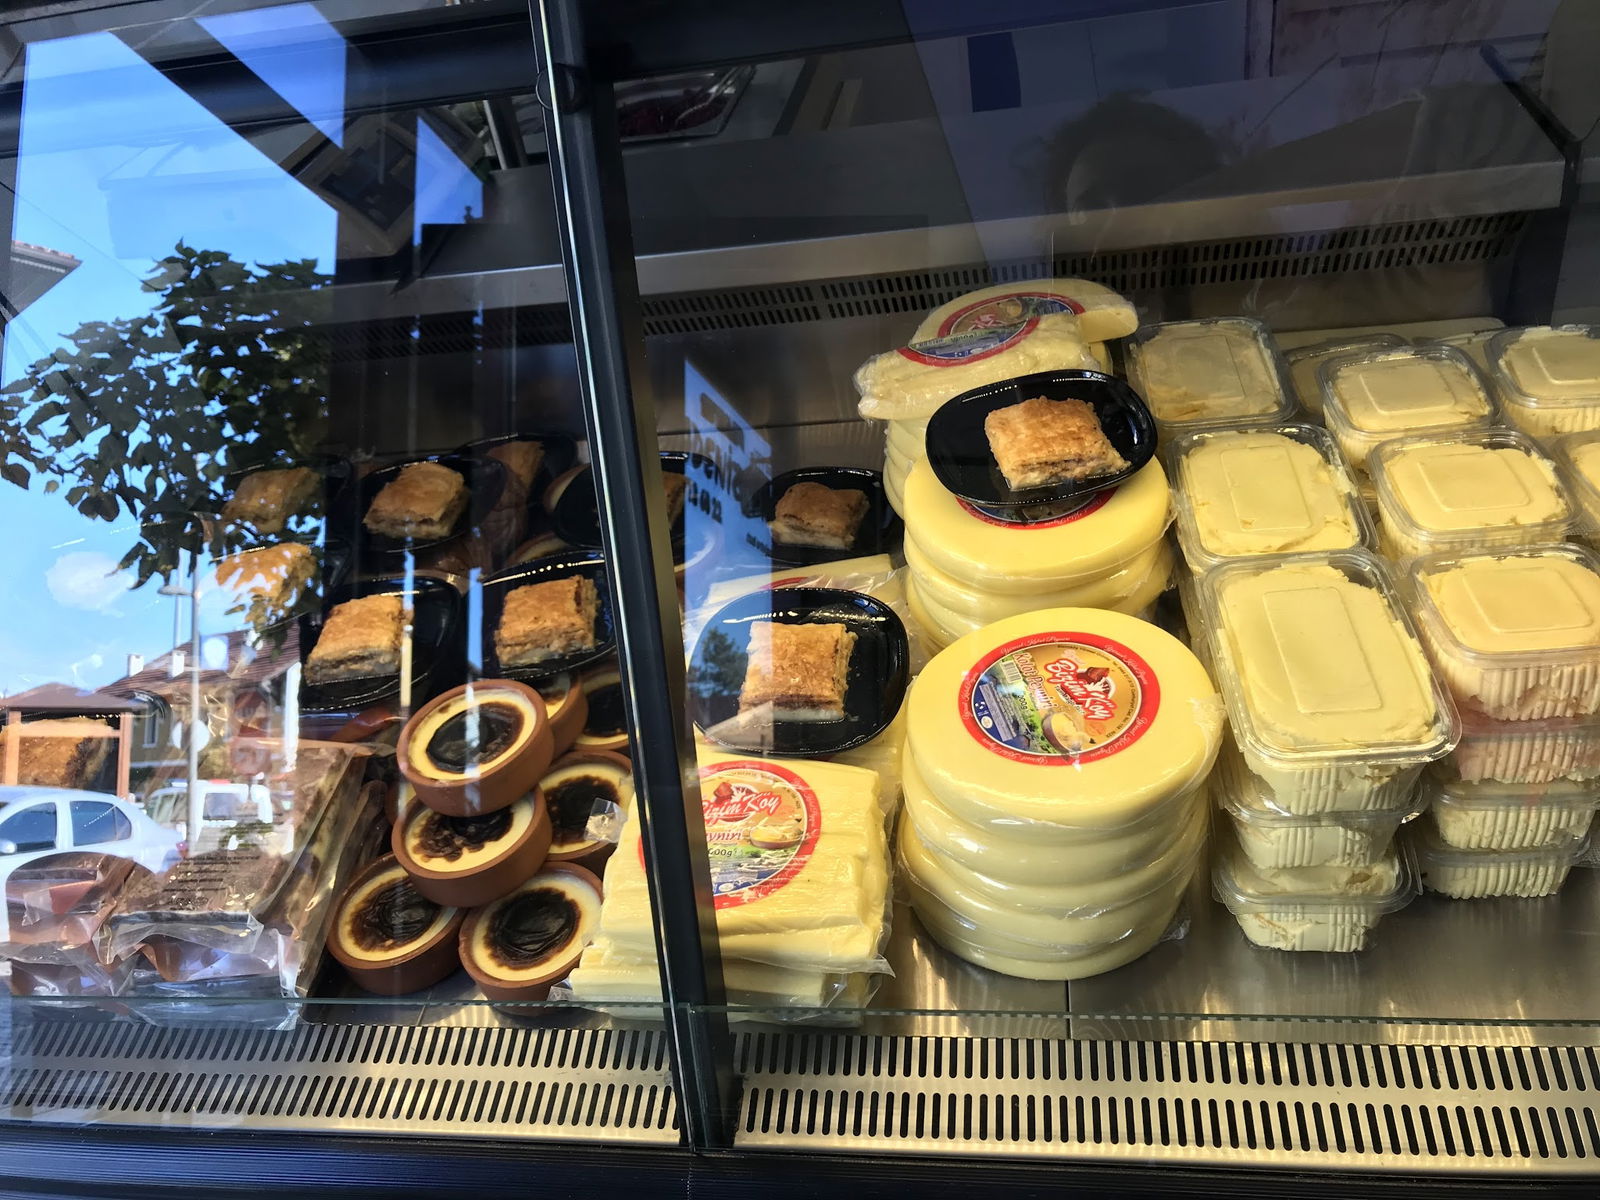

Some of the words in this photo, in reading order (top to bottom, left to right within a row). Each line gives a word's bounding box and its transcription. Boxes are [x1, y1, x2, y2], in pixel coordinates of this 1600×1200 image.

[1046, 659, 1087, 697] Bizim
[1078, 690, 1116, 719] Köy
[743, 792, 780, 814] Köy
